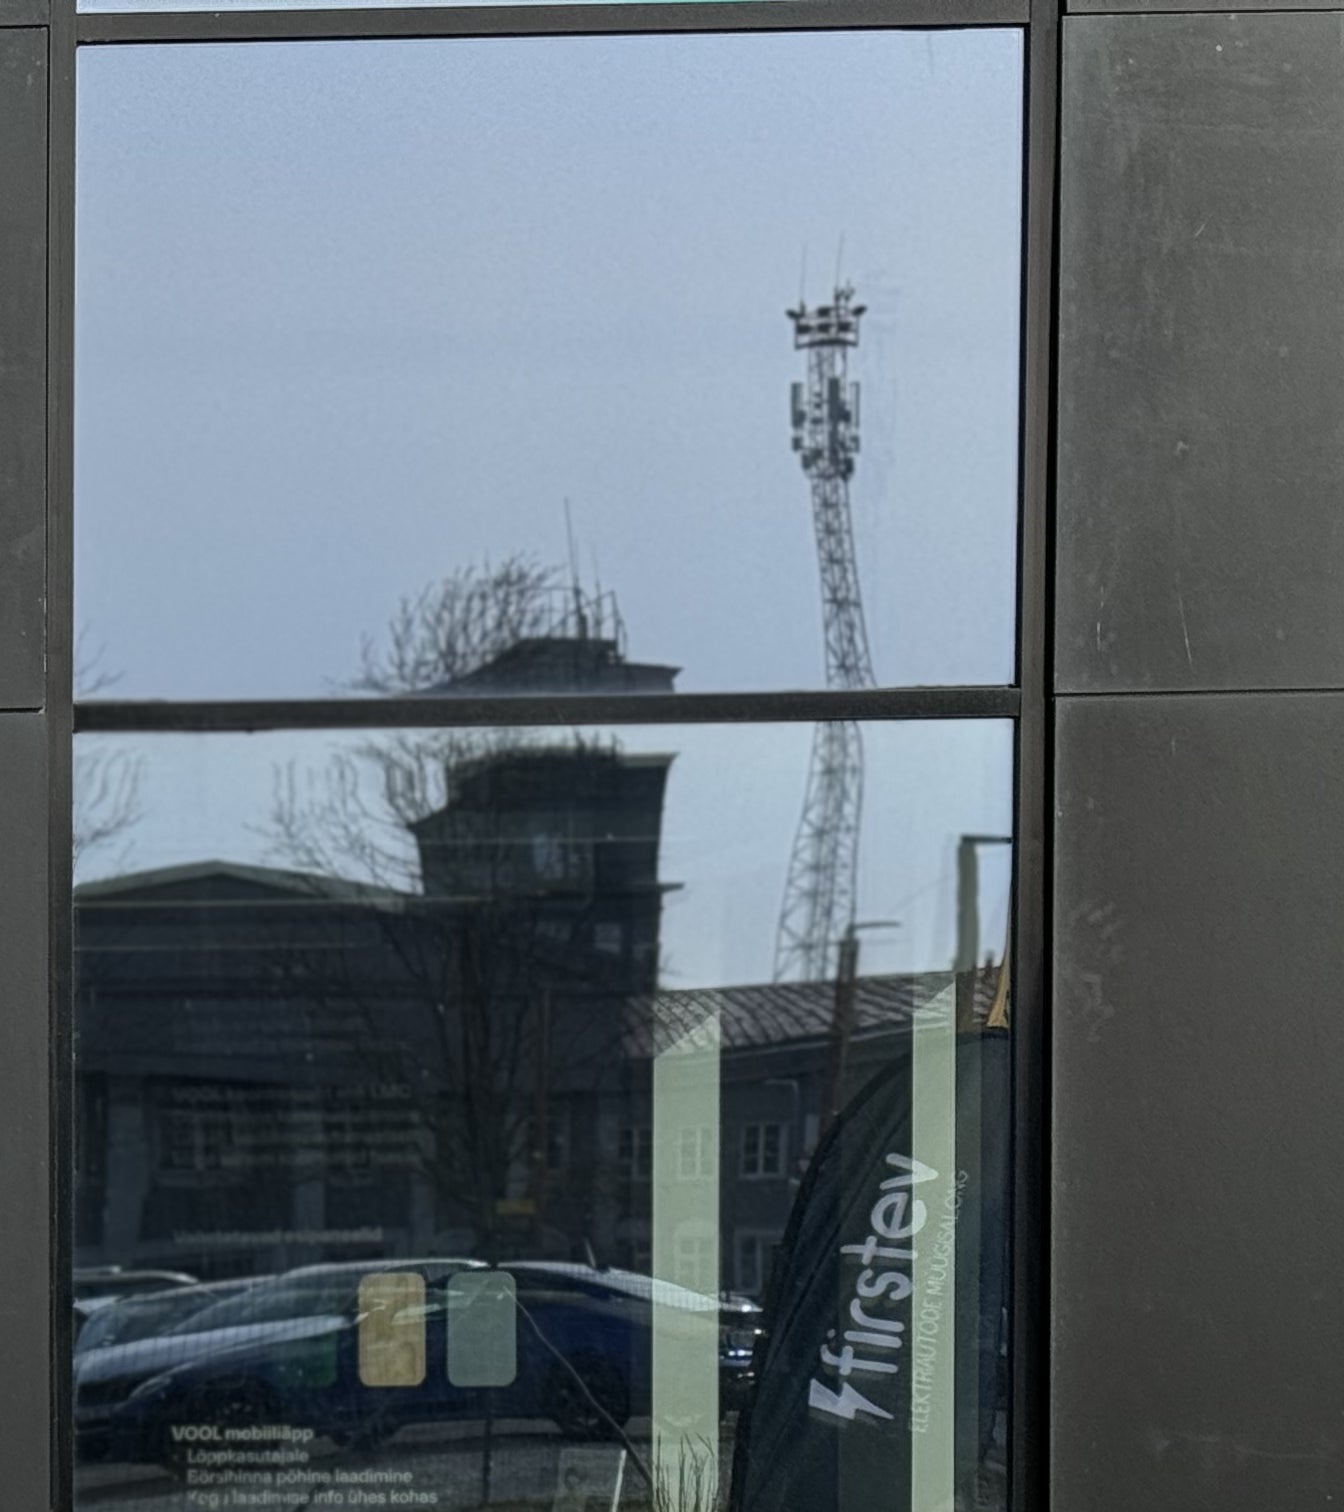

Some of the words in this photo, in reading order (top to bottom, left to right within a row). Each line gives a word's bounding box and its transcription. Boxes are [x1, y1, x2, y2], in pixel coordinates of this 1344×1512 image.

[820, 1153, 939, 1376] firstev
[171, 1426, 222, 1441] VOOL
[335, 1468, 413, 1483] laadimine
[314, 1489, 344, 1504] info
[348, 1489, 387, 1504] ühes
[390, 1489, 438, 1504] kohas
